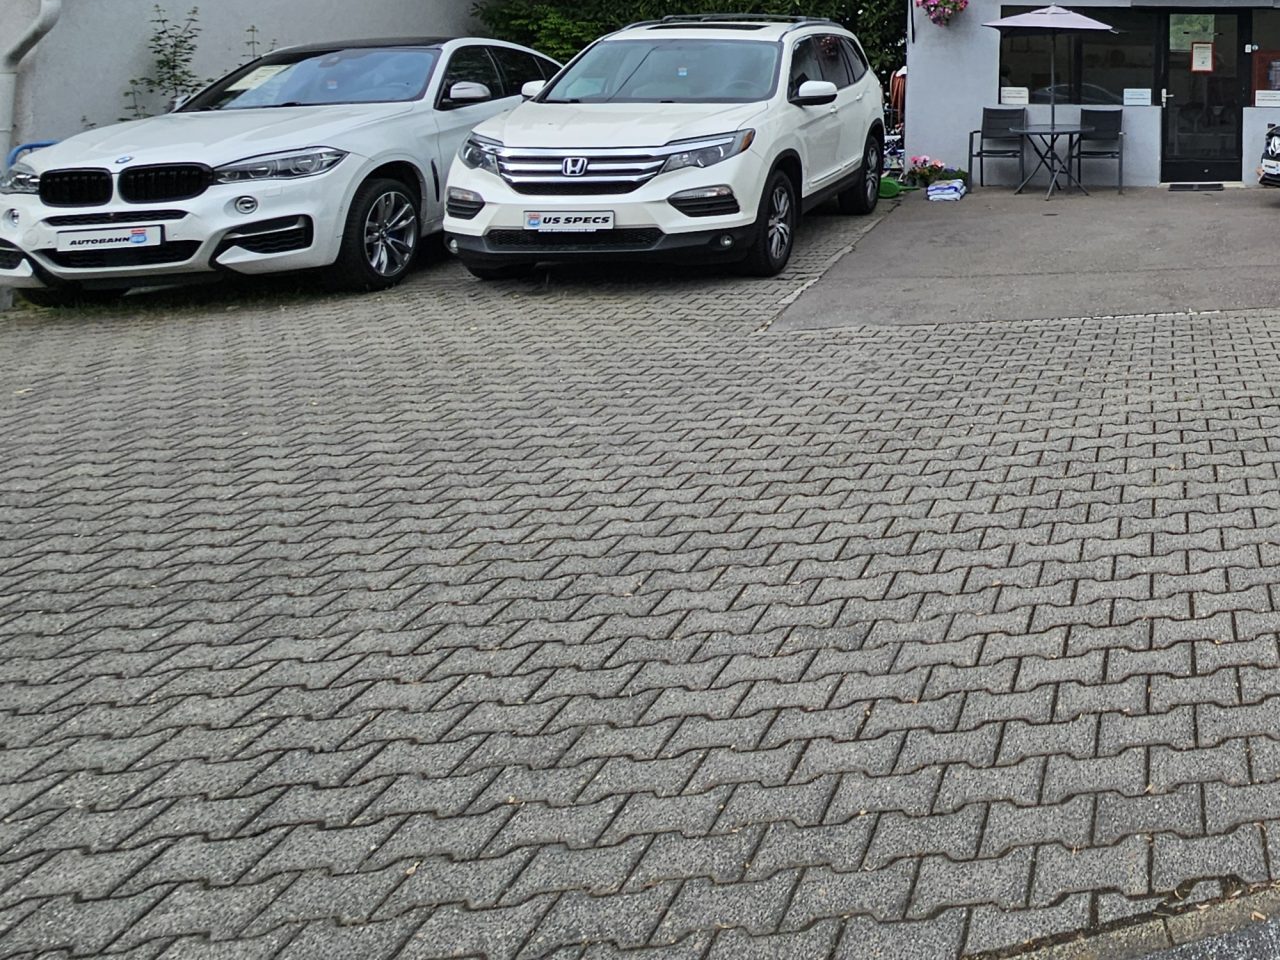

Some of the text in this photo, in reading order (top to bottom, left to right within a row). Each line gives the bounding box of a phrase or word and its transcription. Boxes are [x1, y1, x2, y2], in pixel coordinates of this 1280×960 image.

[543, 216, 561, 224] US
[563, 216, 610, 224] SPECS
[69, 236, 130, 246] AUTOBAHN
